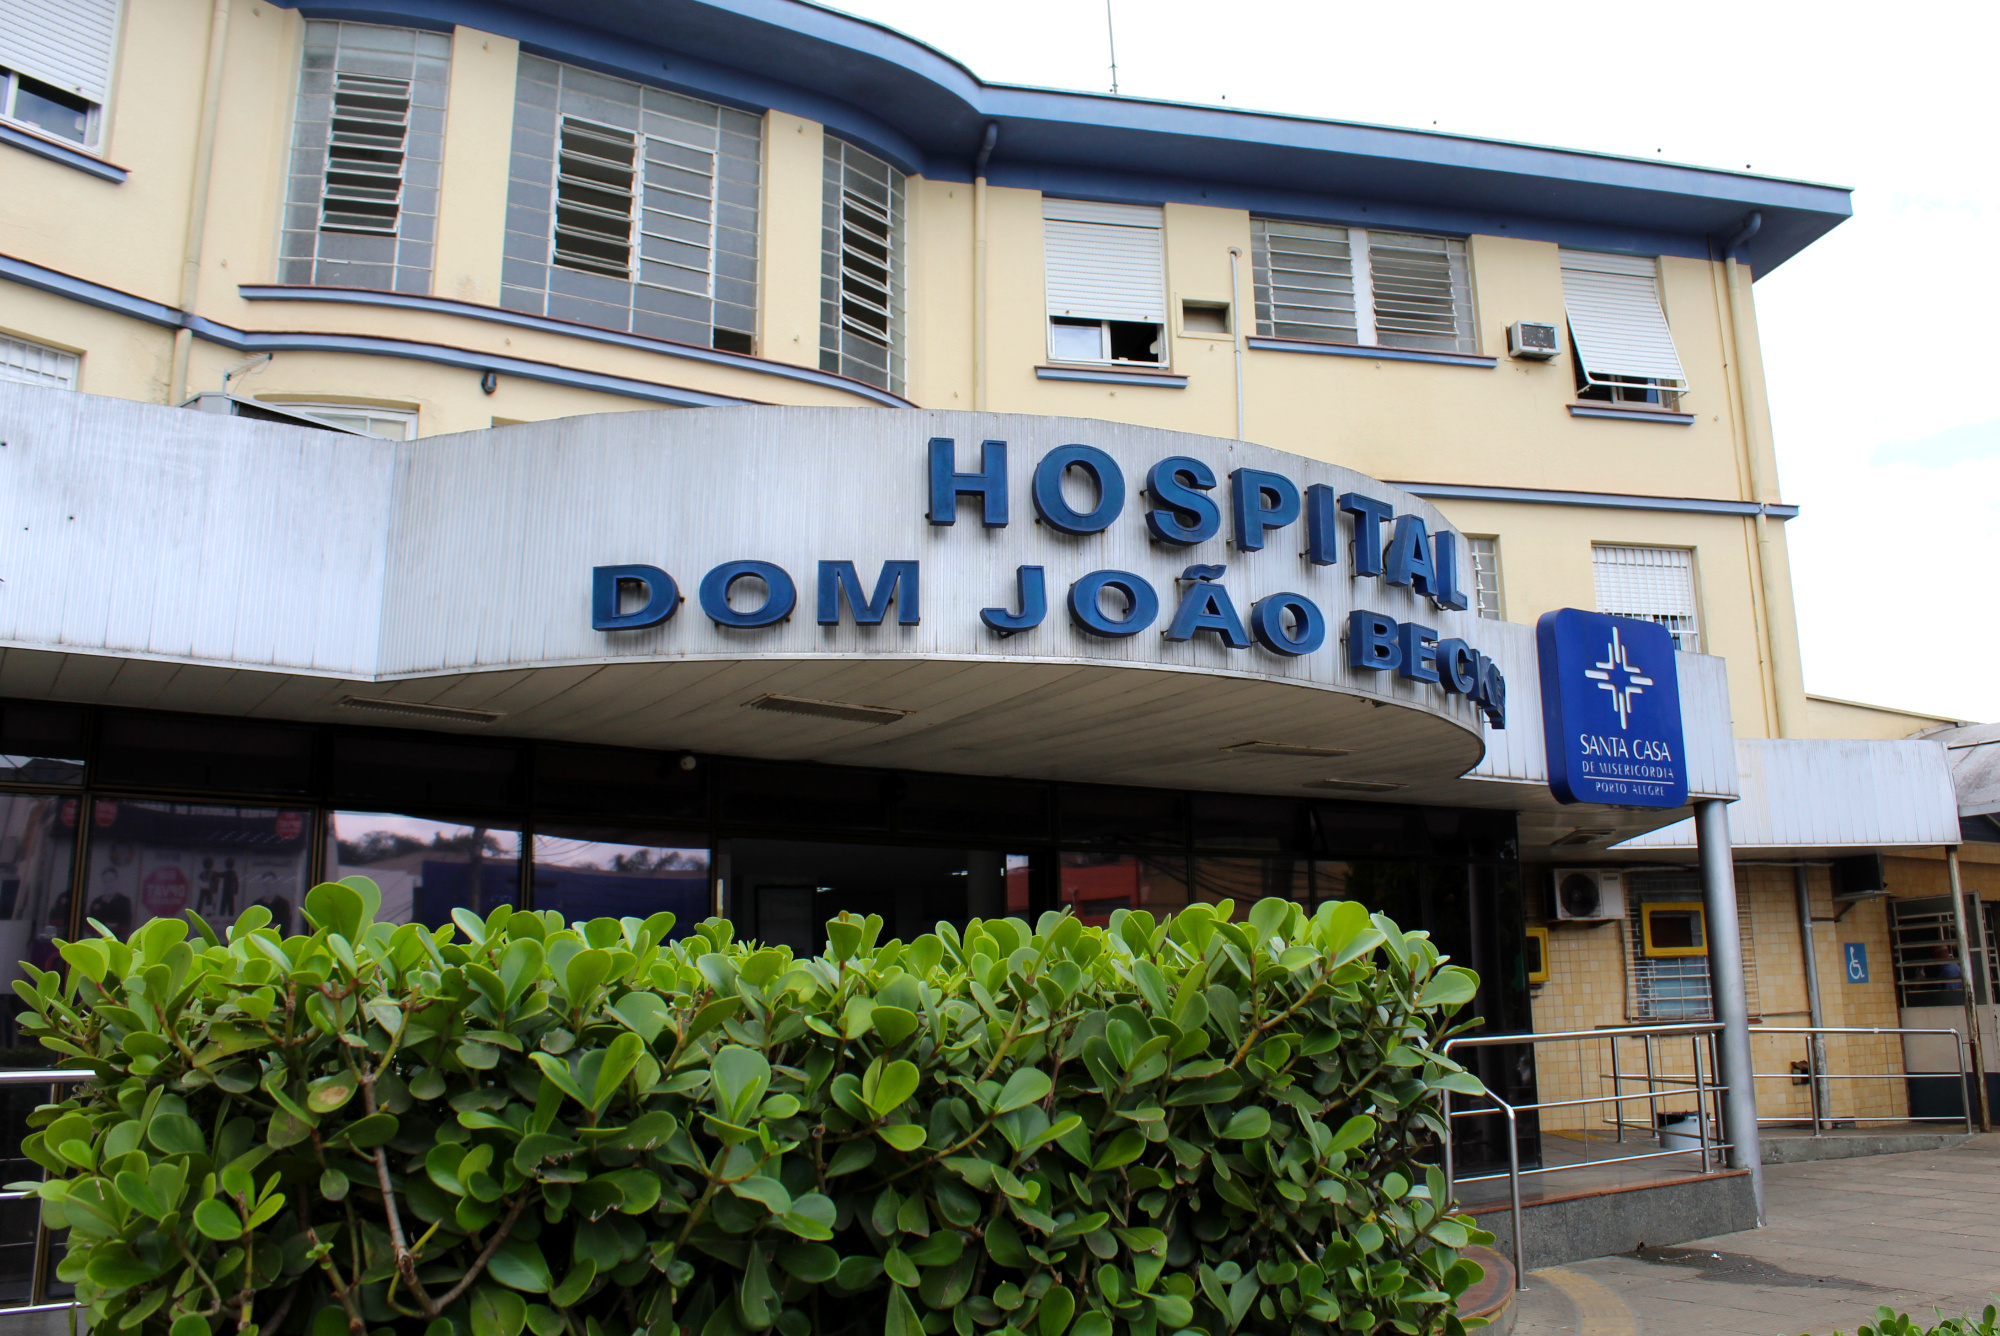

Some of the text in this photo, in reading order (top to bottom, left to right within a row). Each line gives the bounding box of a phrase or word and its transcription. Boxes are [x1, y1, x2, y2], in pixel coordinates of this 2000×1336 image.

[928, 437, 1468, 611] HOSPITAL
[592, 560, 1506, 730] DOM JOÃO BECKE
[1580, 734, 1671, 761] SANTA CASA
[1582, 761, 1674, 778] DE MISERICÓRDIA
[1596, 782, 1664, 796] PORTO ALEGRE
